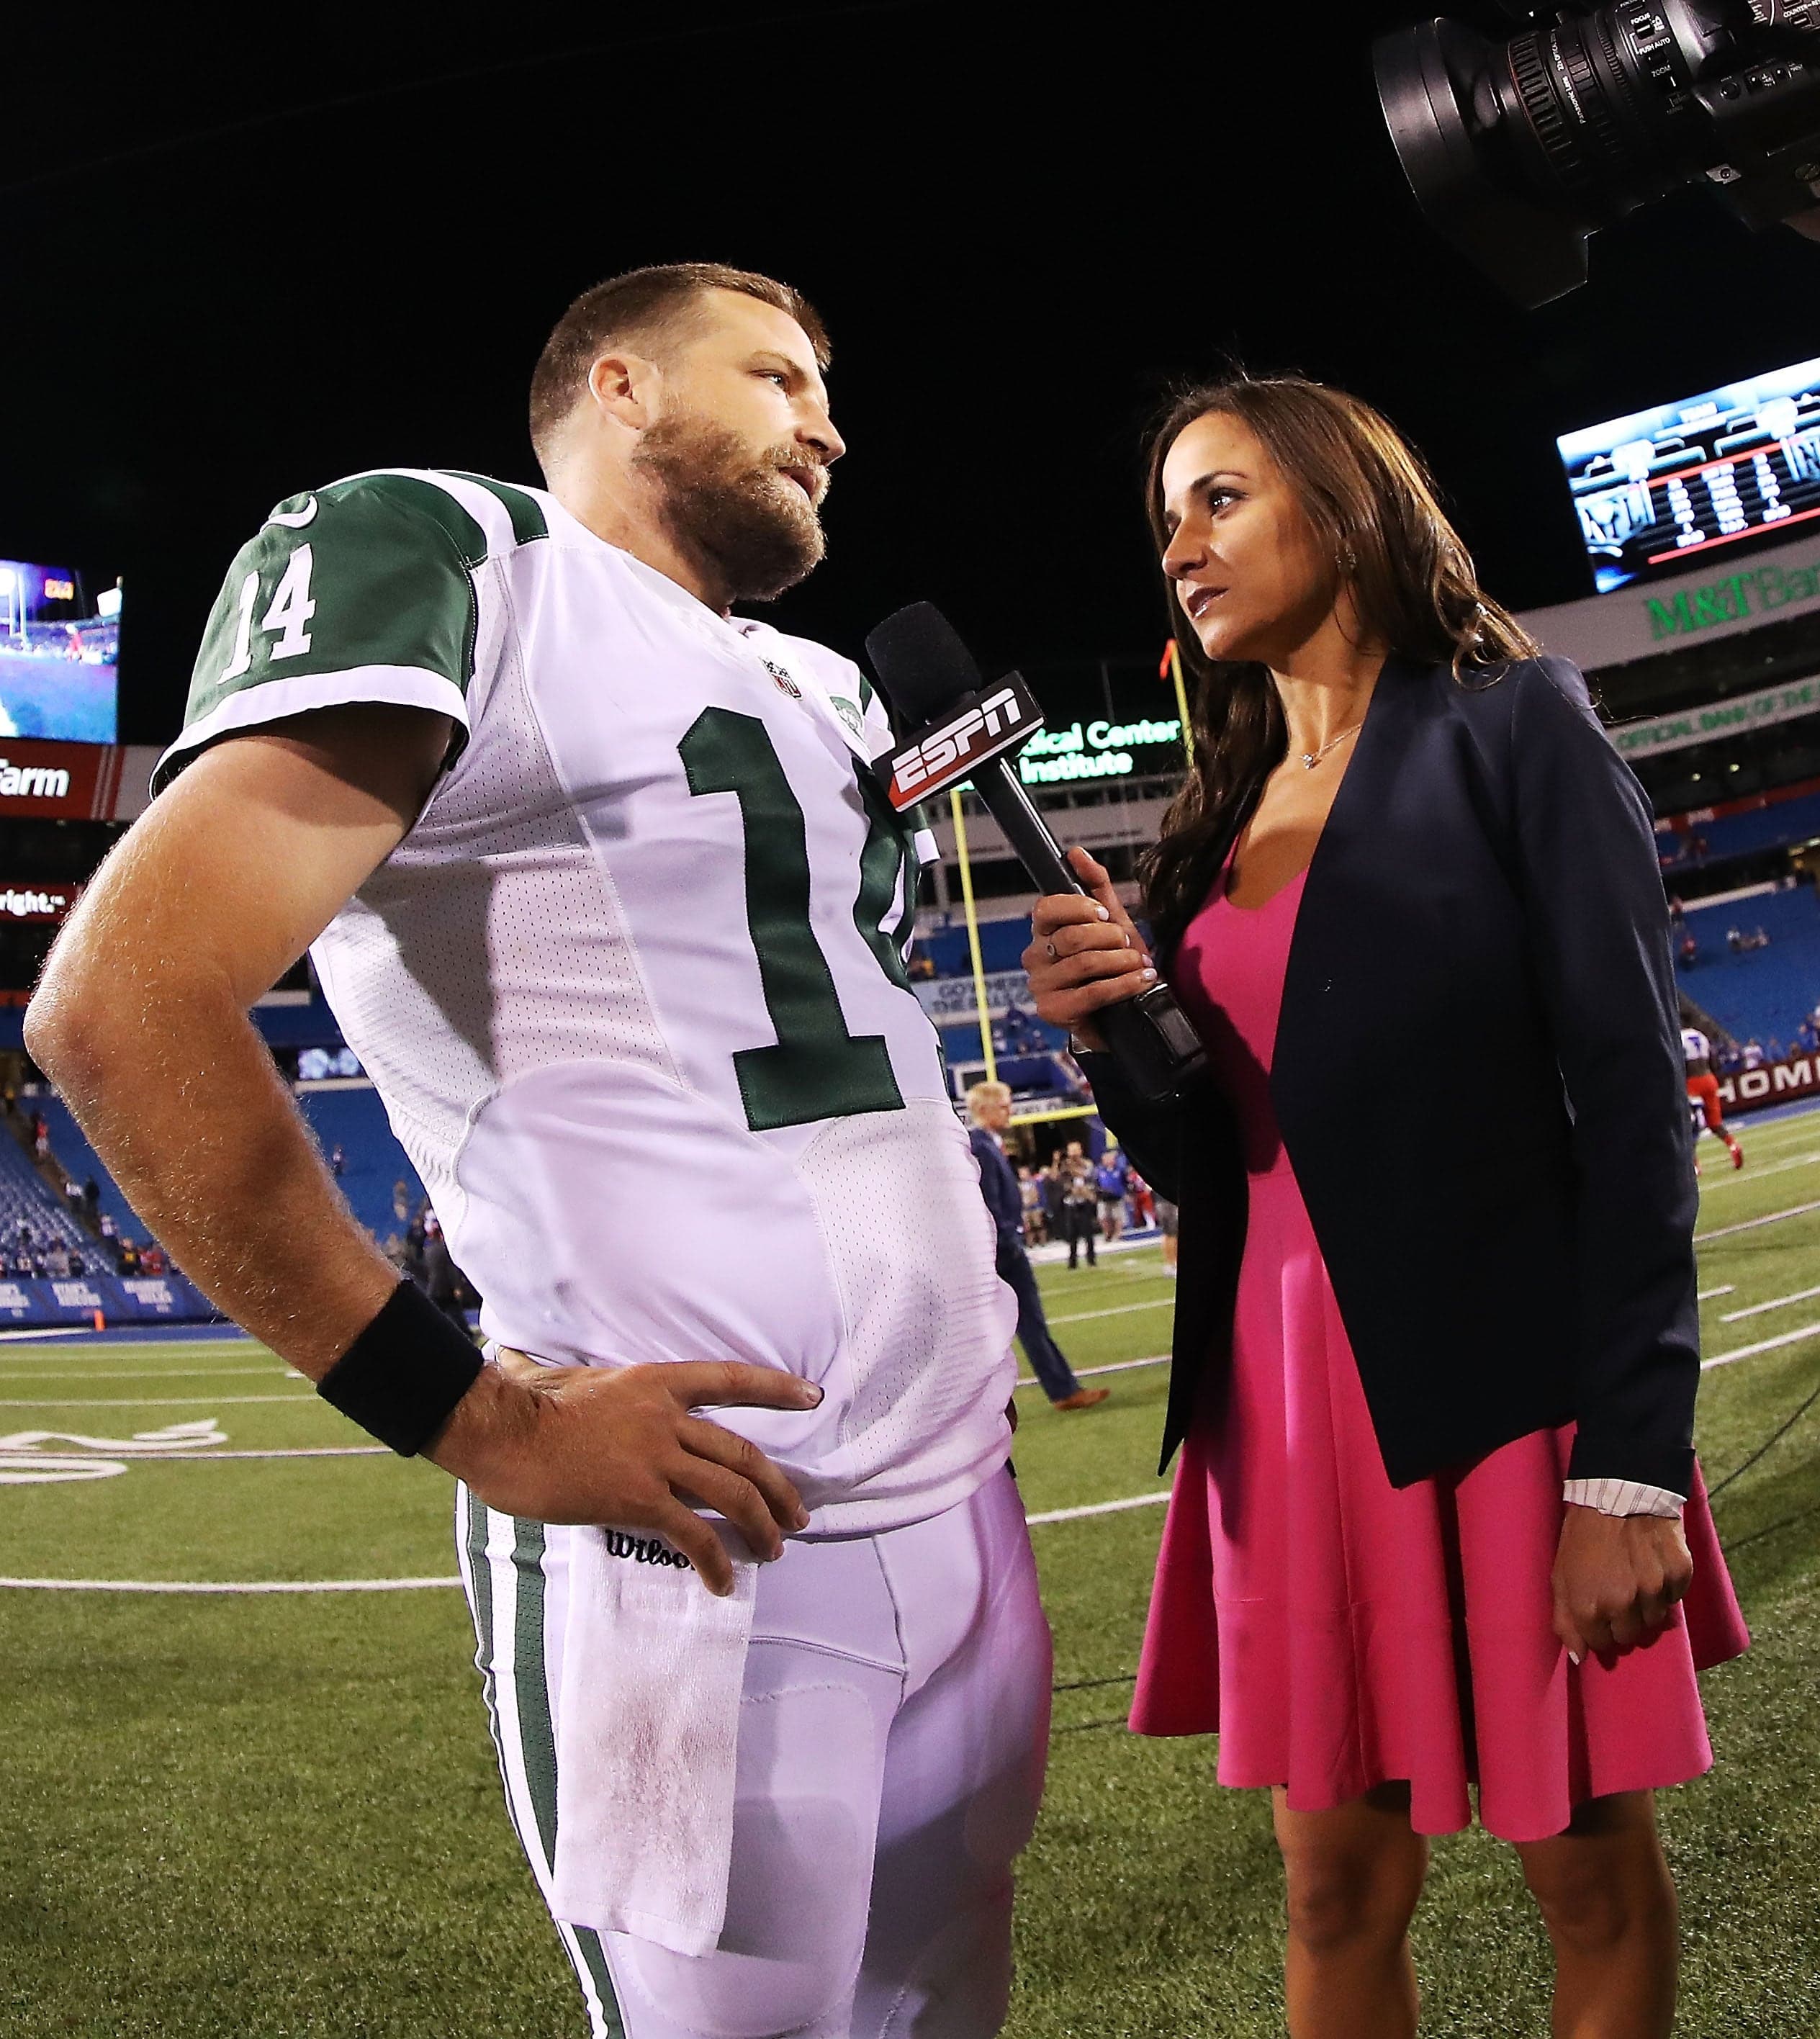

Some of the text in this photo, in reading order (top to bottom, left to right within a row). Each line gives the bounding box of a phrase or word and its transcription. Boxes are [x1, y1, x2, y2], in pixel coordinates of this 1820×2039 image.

[1631, 12, 1651, 24] FOCUS
[1639, 37, 1671, 55] PUSH AUTO
[1568, 91, 1586, 125] Panasonic
[217, 543, 316, 685] 14
[1646, 572, 1752, 641] M&T
[891, 688, 1022, 793] ESPN
[1016, 719, 1181, 757] ical Center
[1019, 751, 1133, 784] Institute
[1716, 1055, 1820, 1103] HOM
[605, 1529, 696, 1571] Wilso
